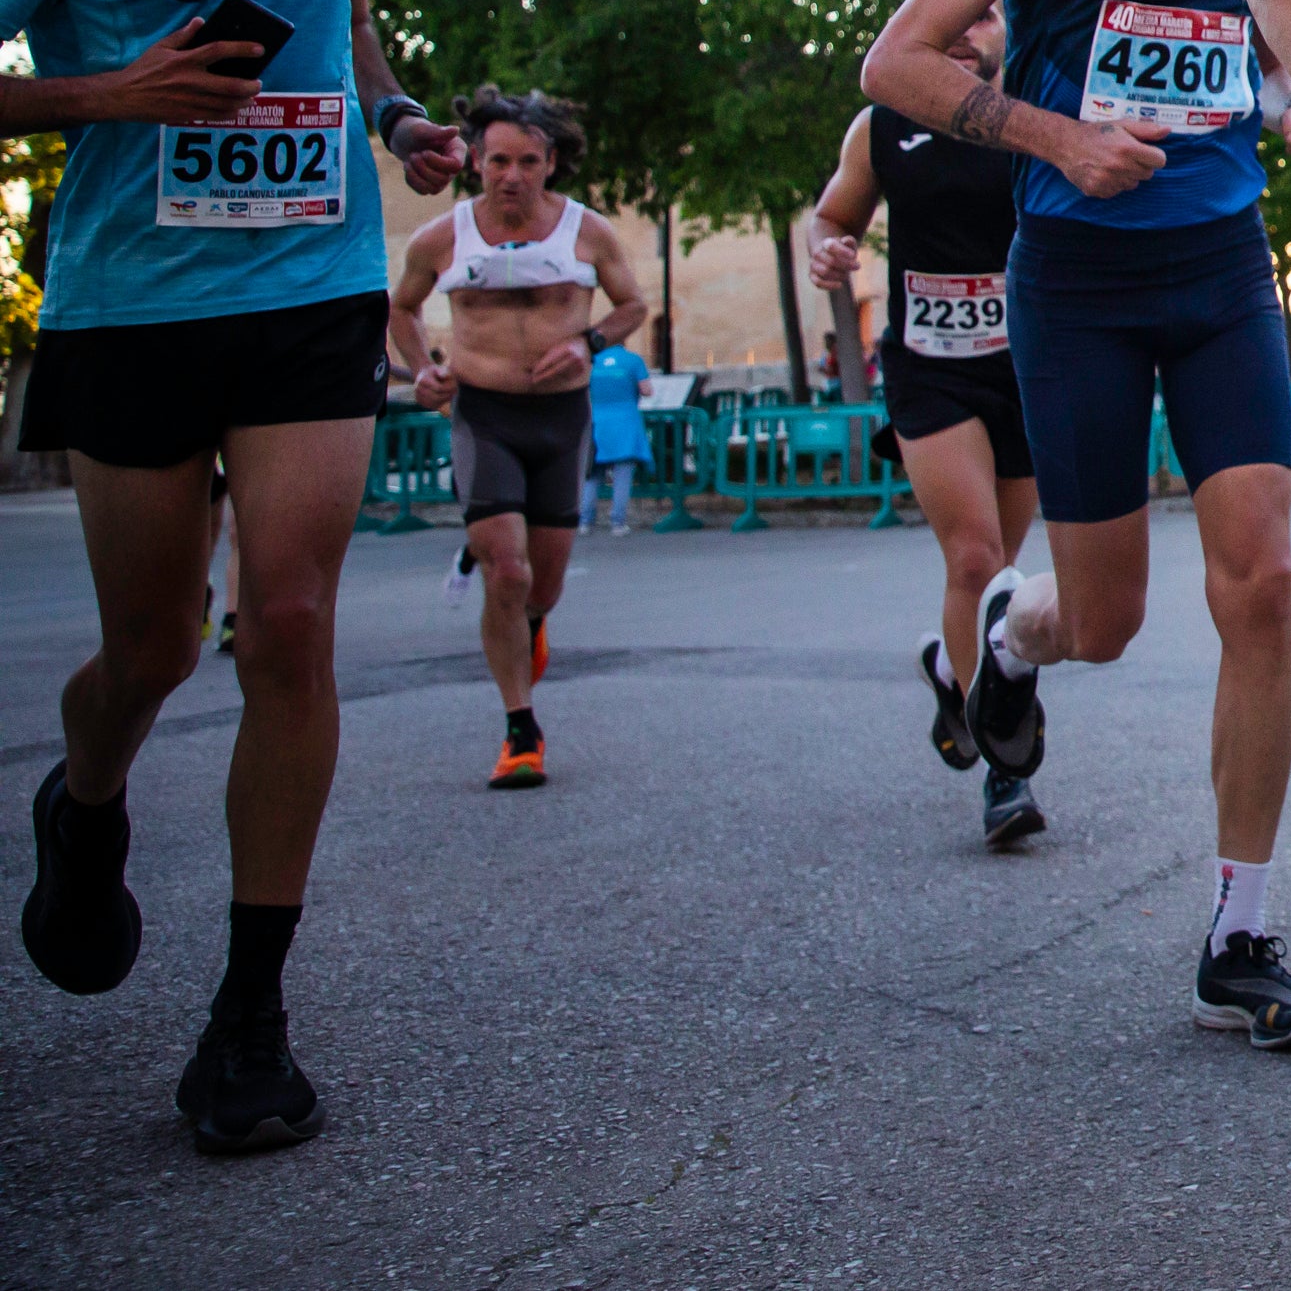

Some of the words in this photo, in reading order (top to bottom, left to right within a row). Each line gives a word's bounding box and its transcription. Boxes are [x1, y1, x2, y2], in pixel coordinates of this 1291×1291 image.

[1108, 4, 1135, 31] 40
[1097, 37, 1228, 93] 4260
[172, 132, 327, 184] 5602
[209, 189, 236, 199] PABLO
[238, 188, 275, 199] CANOVAS
[913, 297, 1005, 330] 2239
